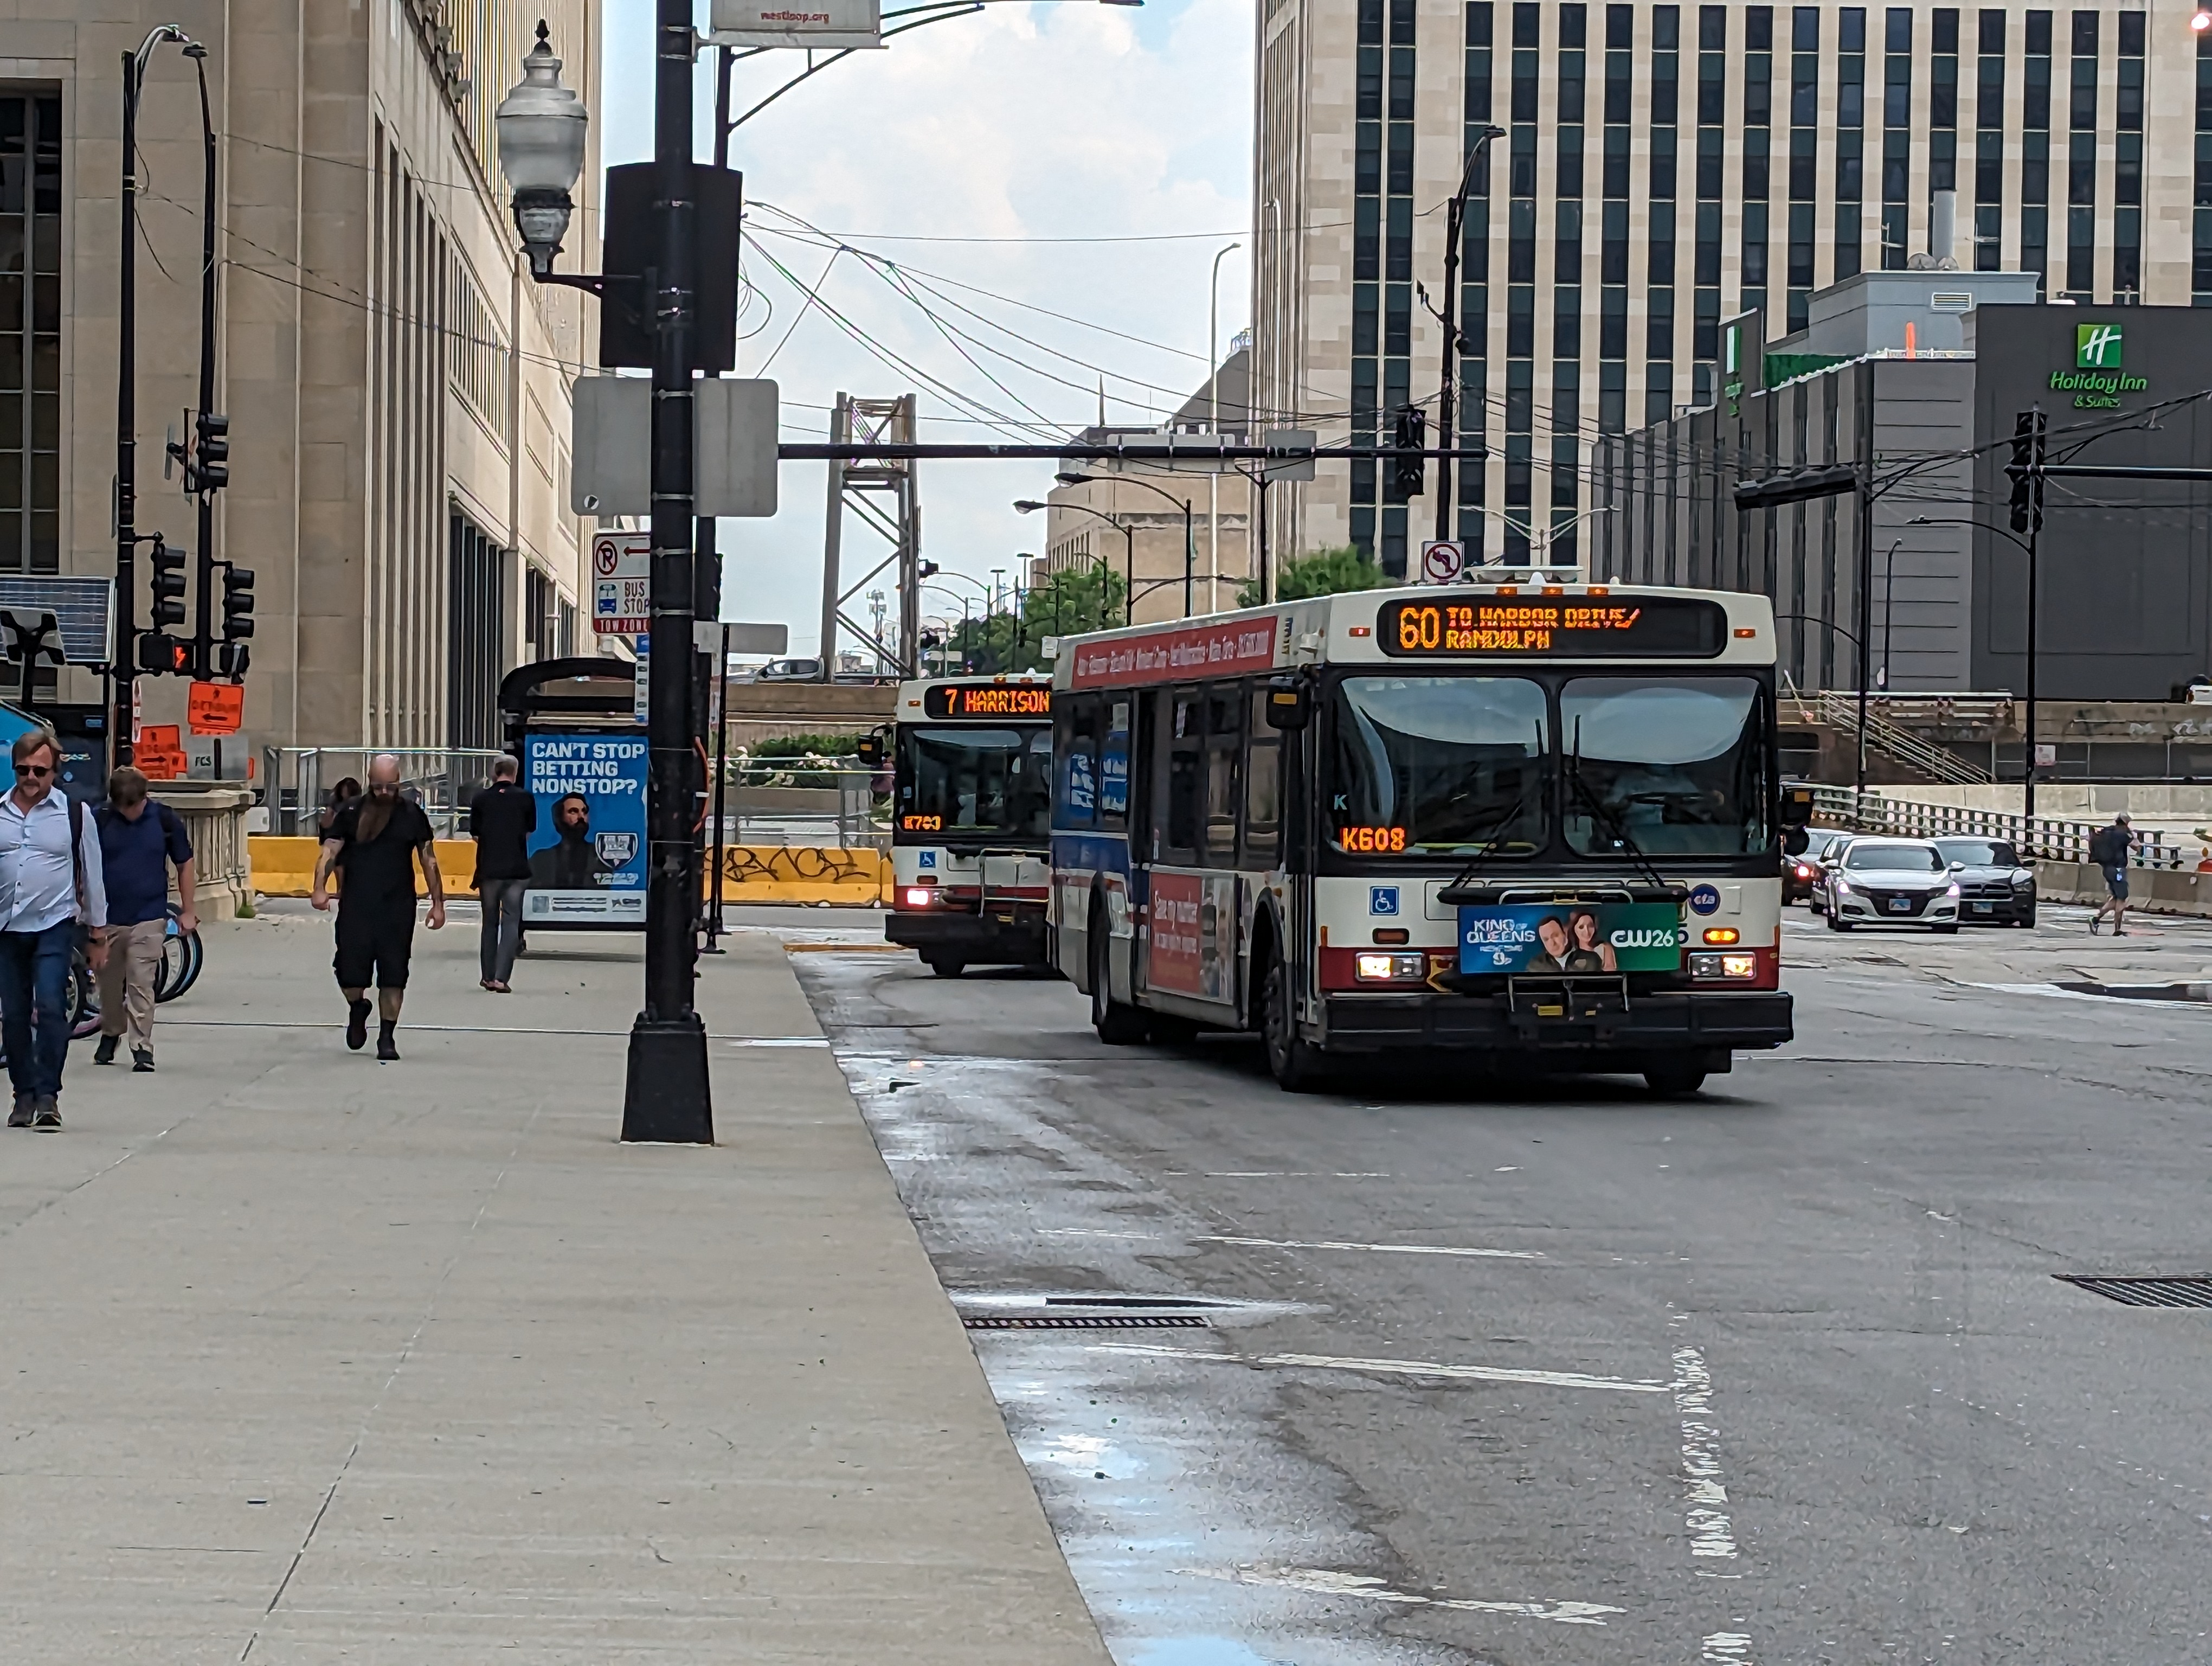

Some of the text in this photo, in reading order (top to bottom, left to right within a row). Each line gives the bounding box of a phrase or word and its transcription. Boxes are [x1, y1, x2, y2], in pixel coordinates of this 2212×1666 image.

[2050, 371, 2147, 394] Holiday Inn
[2086, 395, 2120, 407] Suites
[625, 581, 645, 597] BUS
[624, 598, 650, 614] STOP
[600, 619, 648, 632] TOW ZONE
[1400, 607, 1439, 649] 60
[1446, 607, 1472, 627] TO
[1480, 607, 1558, 628] HARBOR
[1446, 630, 1550, 649] RANDOLPH
[945, 689, 1051, 714] 7 HARRISON
[532, 742, 645, 759] CAN'T STOP
[532, 760, 618, 776] BETTING
[532, 778, 638, 794] NONSTOP?
[1334, 794, 1348, 810] K
[1342, 827, 1405, 850] K608
[1467, 930, 1536, 944] QUEENS
